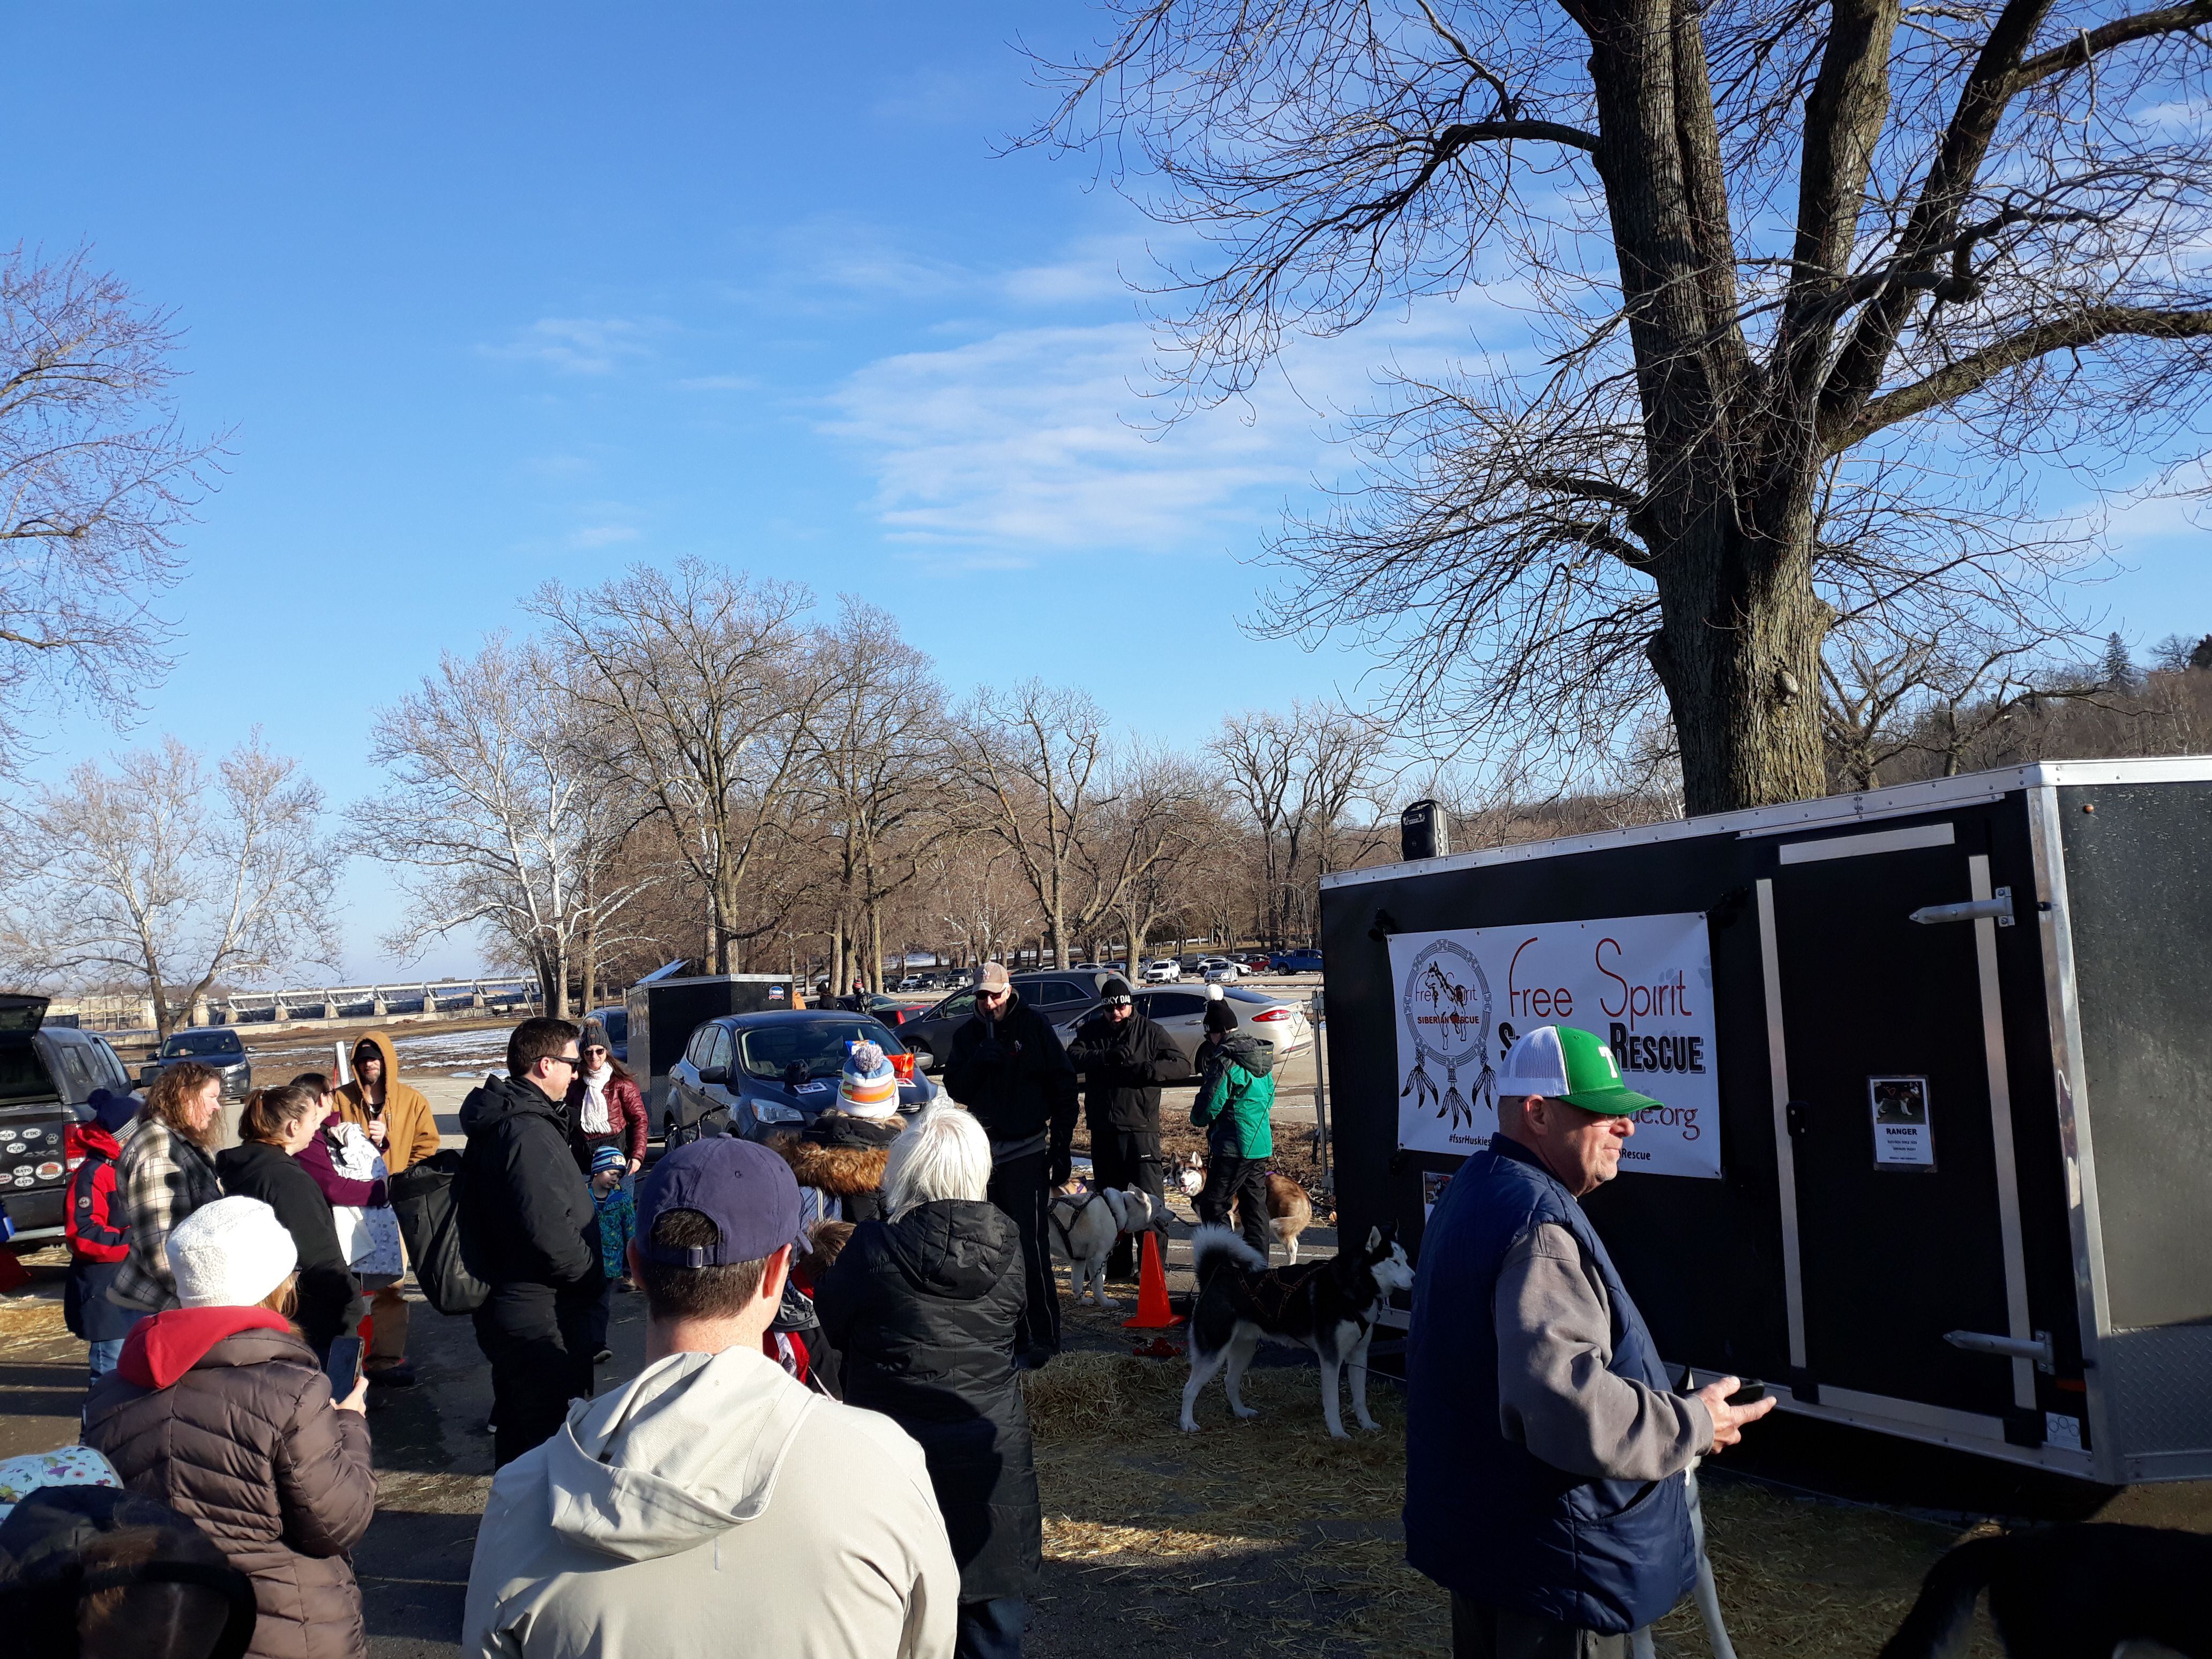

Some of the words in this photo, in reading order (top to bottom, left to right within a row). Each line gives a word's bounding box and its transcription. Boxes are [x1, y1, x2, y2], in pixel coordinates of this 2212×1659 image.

[1509, 937, 1573, 1018] Free
[1595, 938, 1692, 1031] Spirit
[1417, 1016, 1449, 1024] SIBERIAN
[1597, 1046, 1619, 1078] T
[1610, 1022, 1706, 1074] RESCUE
